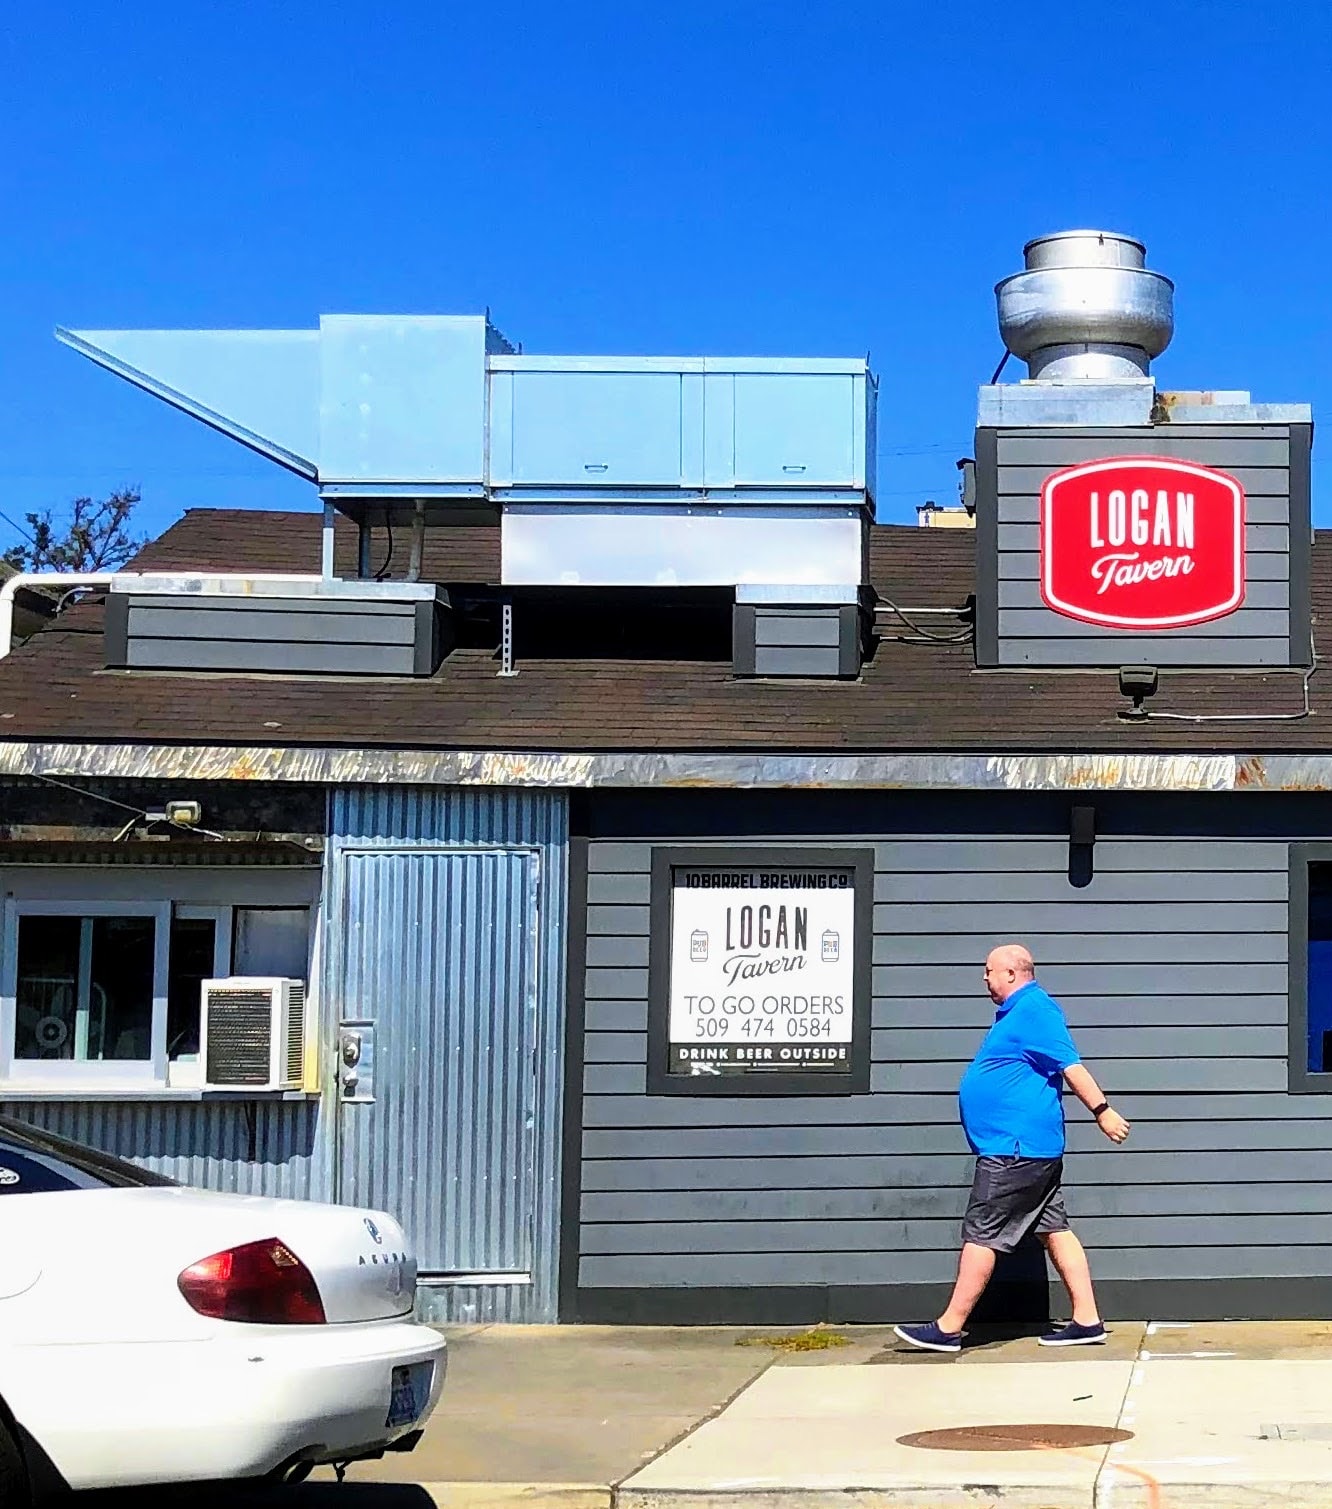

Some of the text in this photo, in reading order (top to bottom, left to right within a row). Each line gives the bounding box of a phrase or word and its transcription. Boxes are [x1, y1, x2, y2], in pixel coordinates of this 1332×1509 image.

[1090, 489, 1194, 549] LOGAN
[1091, 552, 1195, 595] Tavern
[701, 873, 758, 888] BARREL
[759, 873, 826, 888] BREWING
[726, 905, 808, 951] LOGAN
[722, 953, 808, 987] Tavern
[684, 996, 844, 1015] TO GO ORDERS
[696, 1018, 831, 1037] 509 474 0584
[679, 1048, 847, 1060] DRINK BEER OUTSIDE
